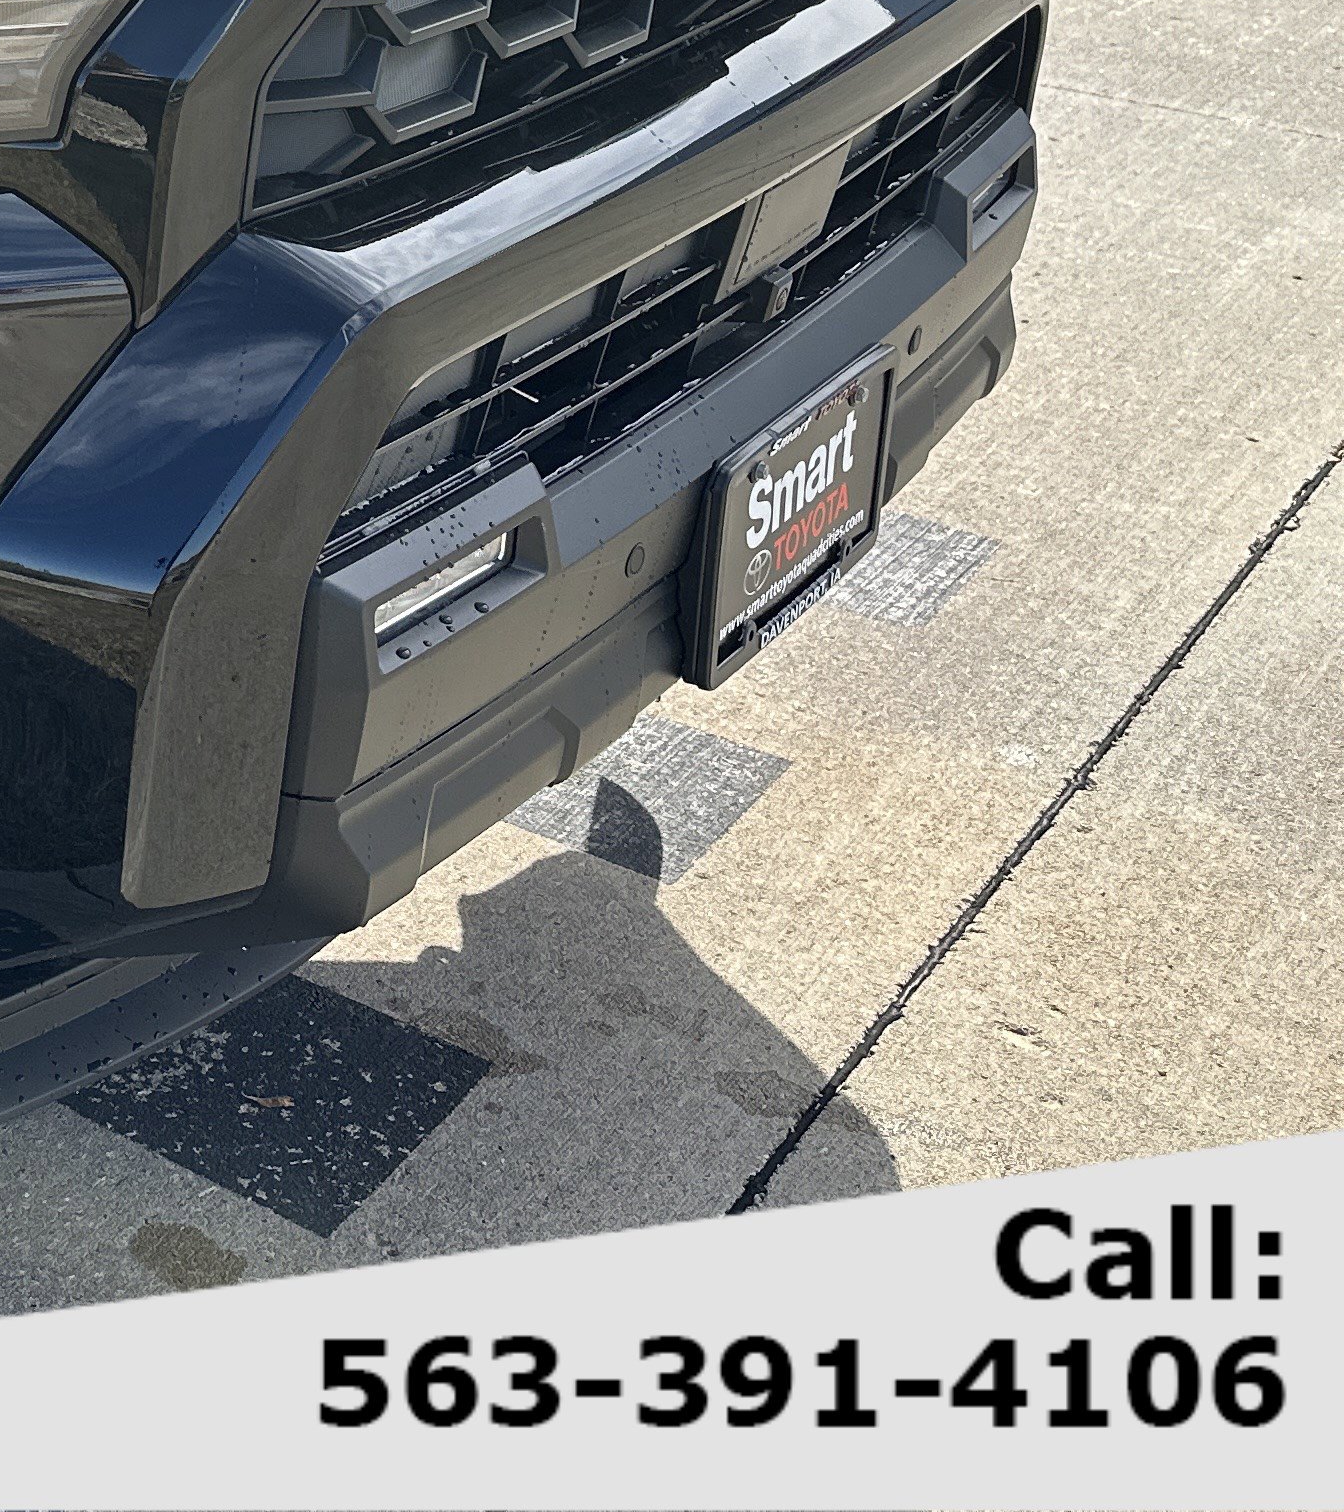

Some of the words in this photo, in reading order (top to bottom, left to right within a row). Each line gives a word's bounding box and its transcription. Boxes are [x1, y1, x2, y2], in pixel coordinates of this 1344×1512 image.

[746, 410, 858, 549] Smart
[774, 482, 850, 570] TOYOTA
[719, 509, 864, 641] www.smarttoyotaquadcities.com
[830, 567, 842, 586] IA
